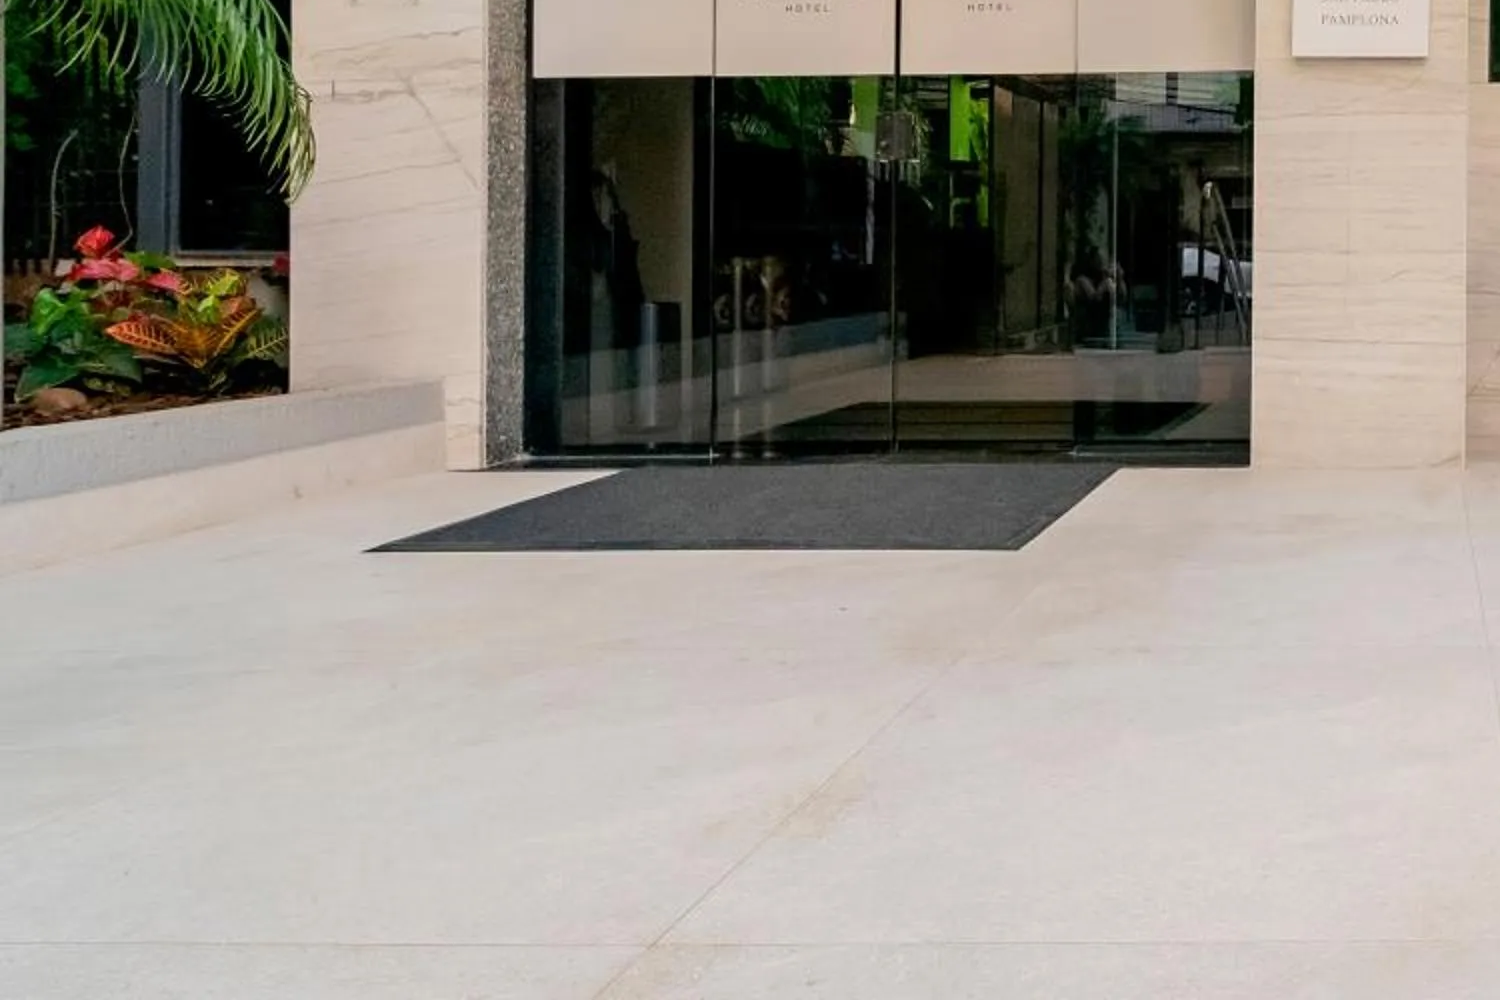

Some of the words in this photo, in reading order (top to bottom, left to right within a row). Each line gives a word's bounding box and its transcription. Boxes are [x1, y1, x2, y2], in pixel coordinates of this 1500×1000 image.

[785, 3, 830, 12] HOTEL
[967, 3, 1012, 12] HOTEL
[1321, 14, 1400, 25] PAMPLONA
